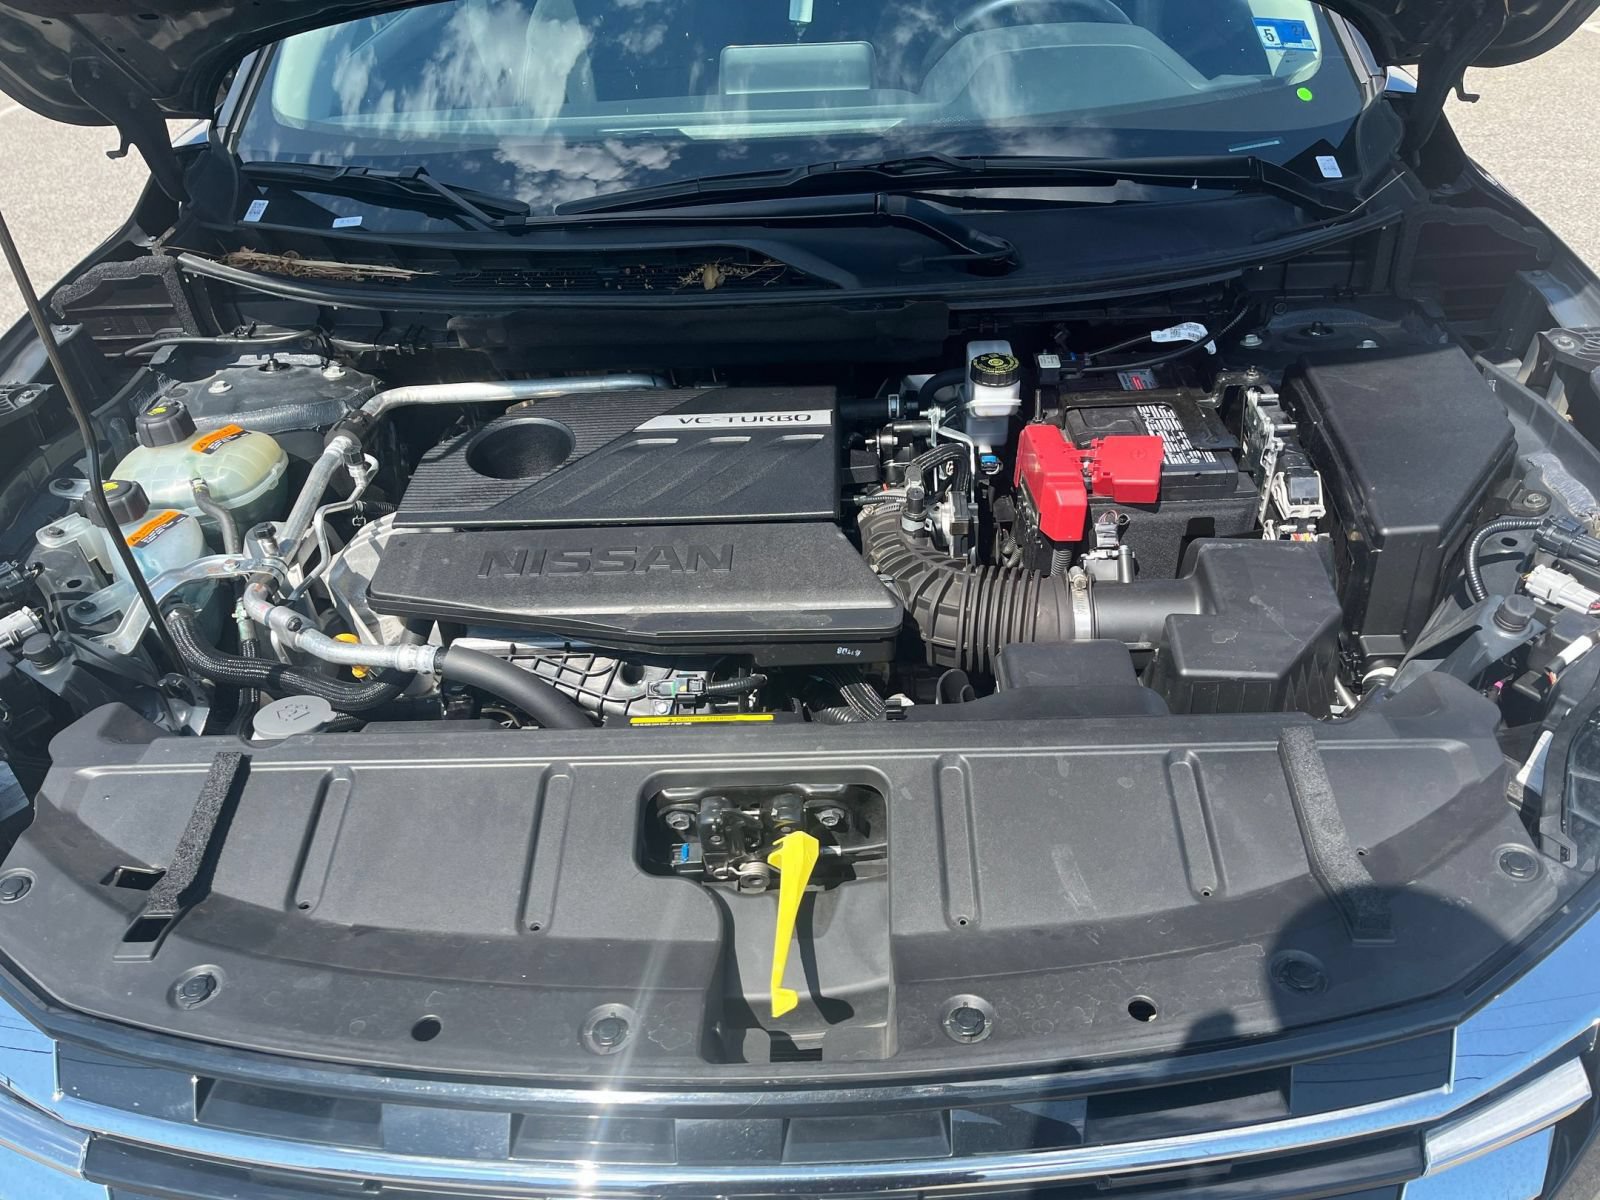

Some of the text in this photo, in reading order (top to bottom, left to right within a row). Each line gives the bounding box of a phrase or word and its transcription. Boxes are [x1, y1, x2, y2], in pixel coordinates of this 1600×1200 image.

[1263, 28, 1275, 42] 5
[678, 413, 812, 425] VC-TURBO
[477, 543, 735, 579] NISSAN
